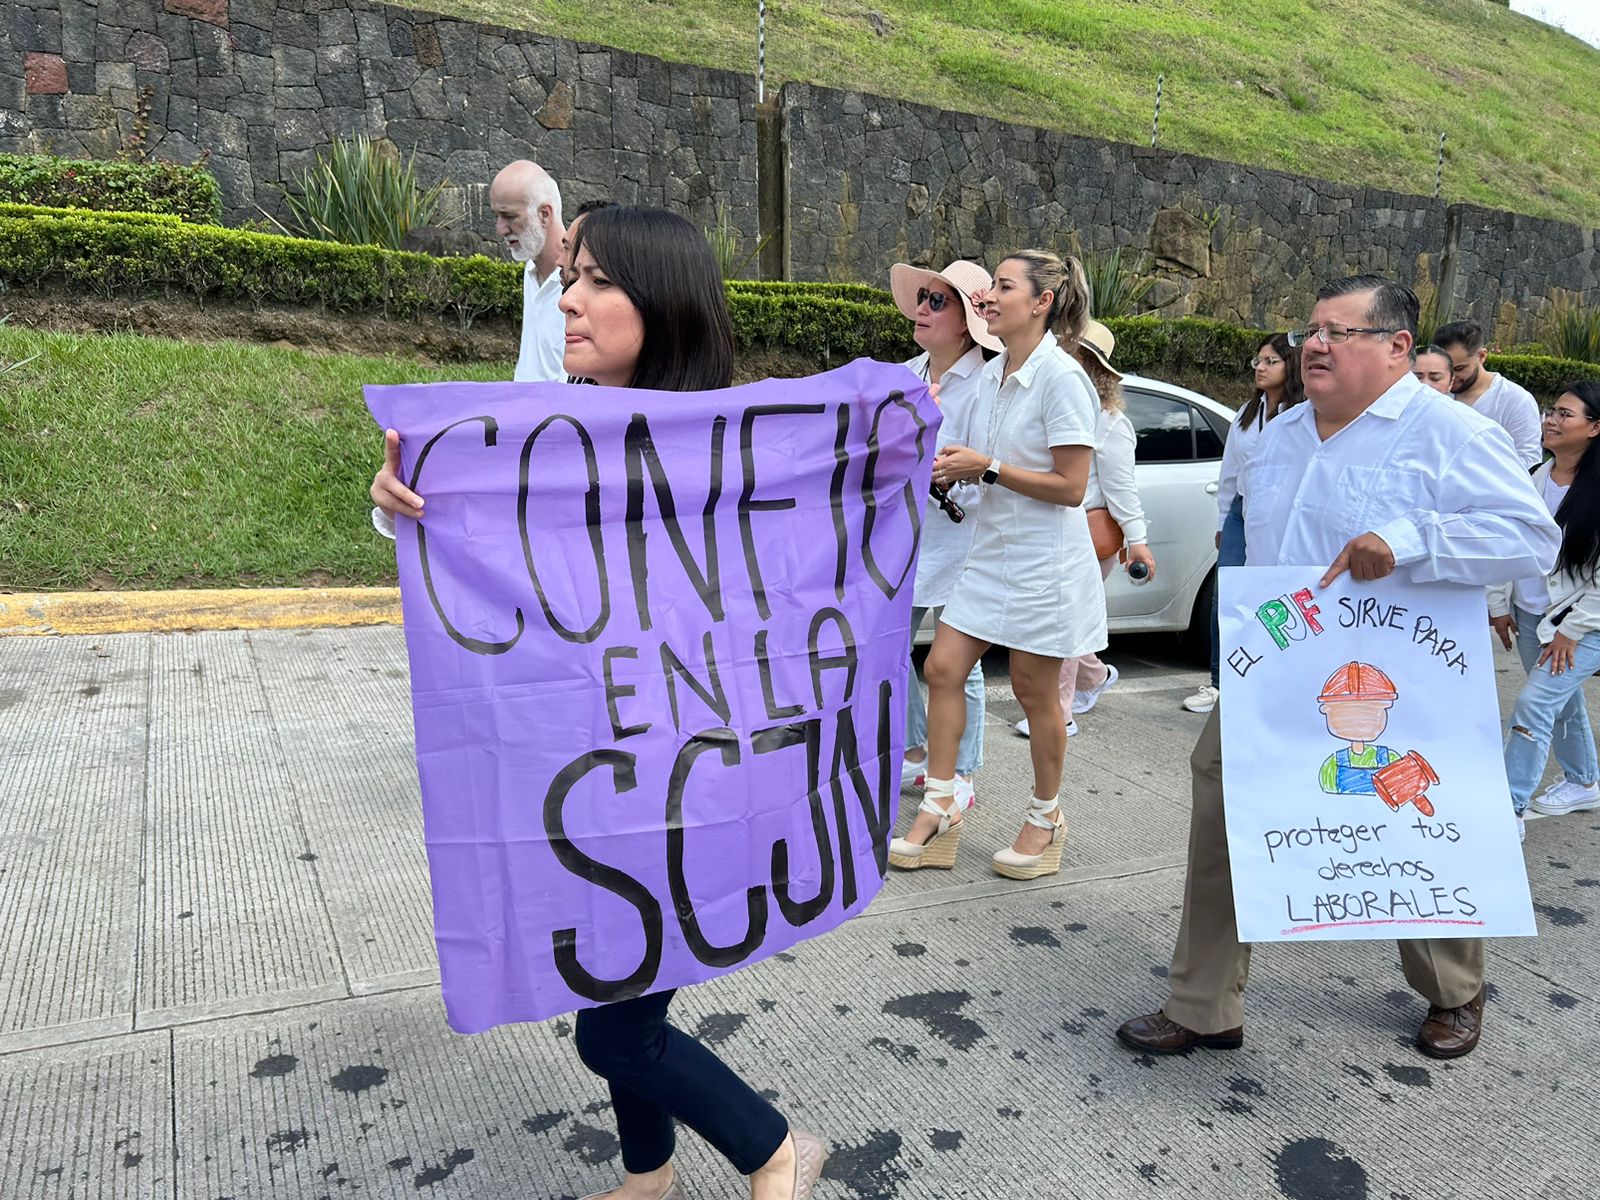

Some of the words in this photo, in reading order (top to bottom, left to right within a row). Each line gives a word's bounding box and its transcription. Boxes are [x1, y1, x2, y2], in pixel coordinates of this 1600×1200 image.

[409, 390, 927, 655] CONFIO
[604, 631, 731, 741] EN
[754, 606, 858, 720] LA
[1226, 646, 1263, 677] EL
[1255, 587, 1324, 651] PJF
[1338, 597, 1408, 630] SIRVE
[1412, 615, 1468, 676] PARA
[543, 679, 892, 1003] SCJN
[1264, 816, 1387, 862] proteger
[1411, 817, 1461, 842] tus
[1318, 857, 1434, 881] derechos
[1286, 886, 1477, 922] LABORALES
